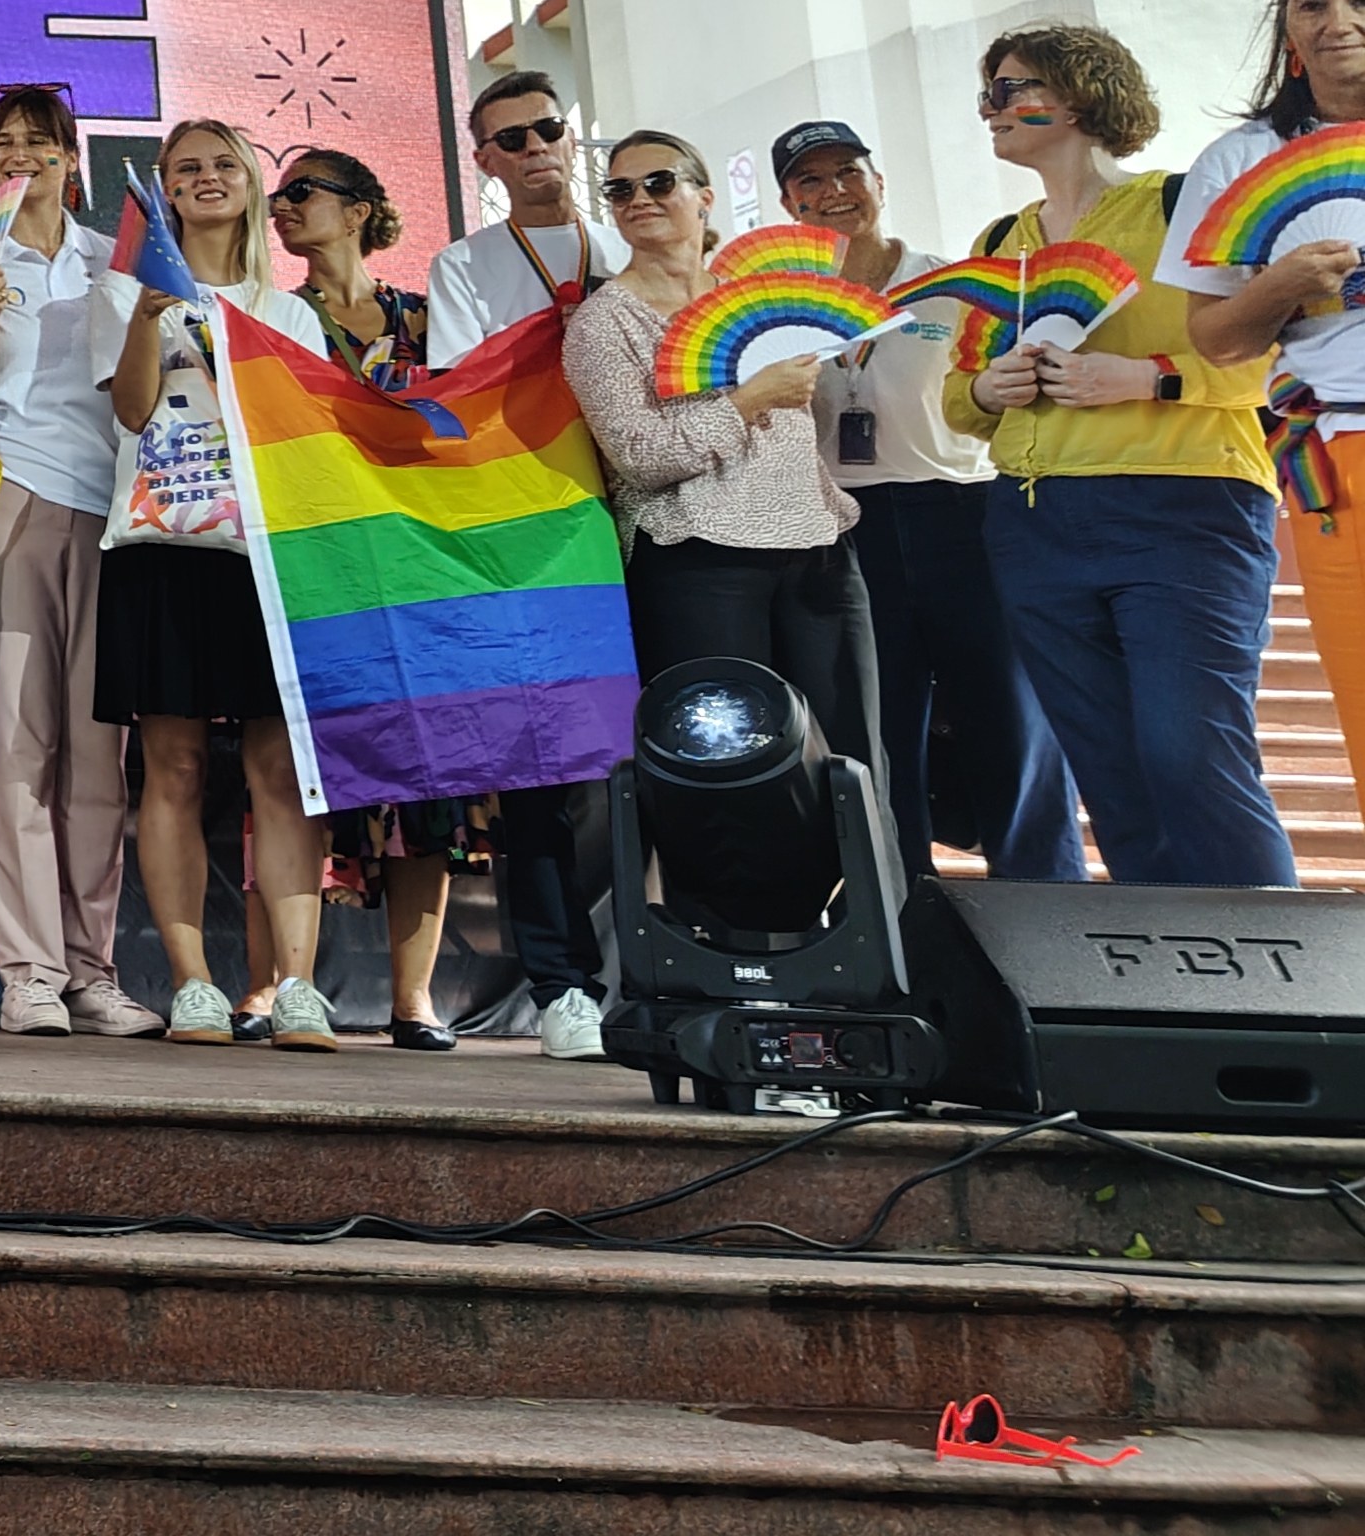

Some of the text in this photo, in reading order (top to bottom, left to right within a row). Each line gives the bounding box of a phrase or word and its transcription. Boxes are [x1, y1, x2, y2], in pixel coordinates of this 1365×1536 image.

[170, 433, 202, 449] NO
[143, 447, 231, 473] GENDER
[147, 467, 232, 490] BIASES
[157, 487, 220, 506] HERE
[1083, 932, 1305, 983] FBT
